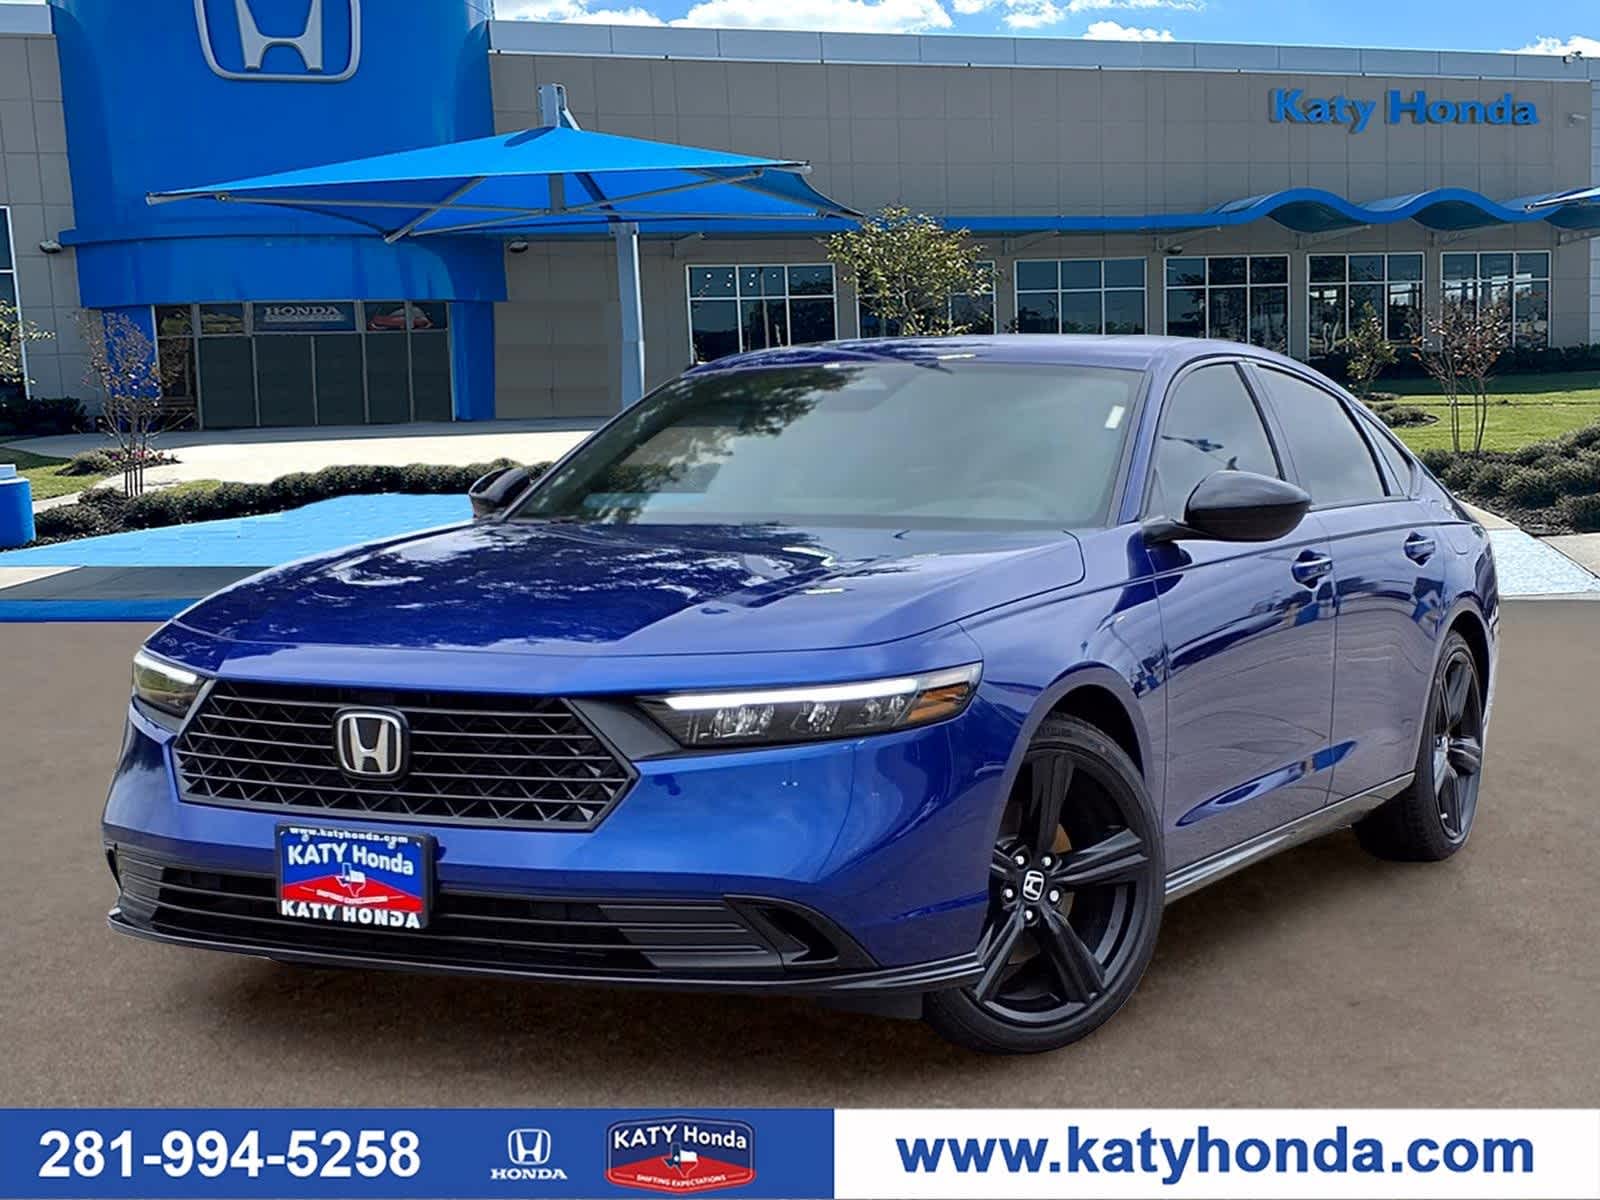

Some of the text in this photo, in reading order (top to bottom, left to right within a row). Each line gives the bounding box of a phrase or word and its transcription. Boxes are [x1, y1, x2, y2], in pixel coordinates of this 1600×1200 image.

[1272, 87, 1539, 133] Katy Honda
[265, 305, 341, 316] HONDA
[289, 827, 409, 844] www.katyhonda.com
[287, 842, 414, 876] KATY Honda
[281, 900, 421, 929] KATY HONDA
